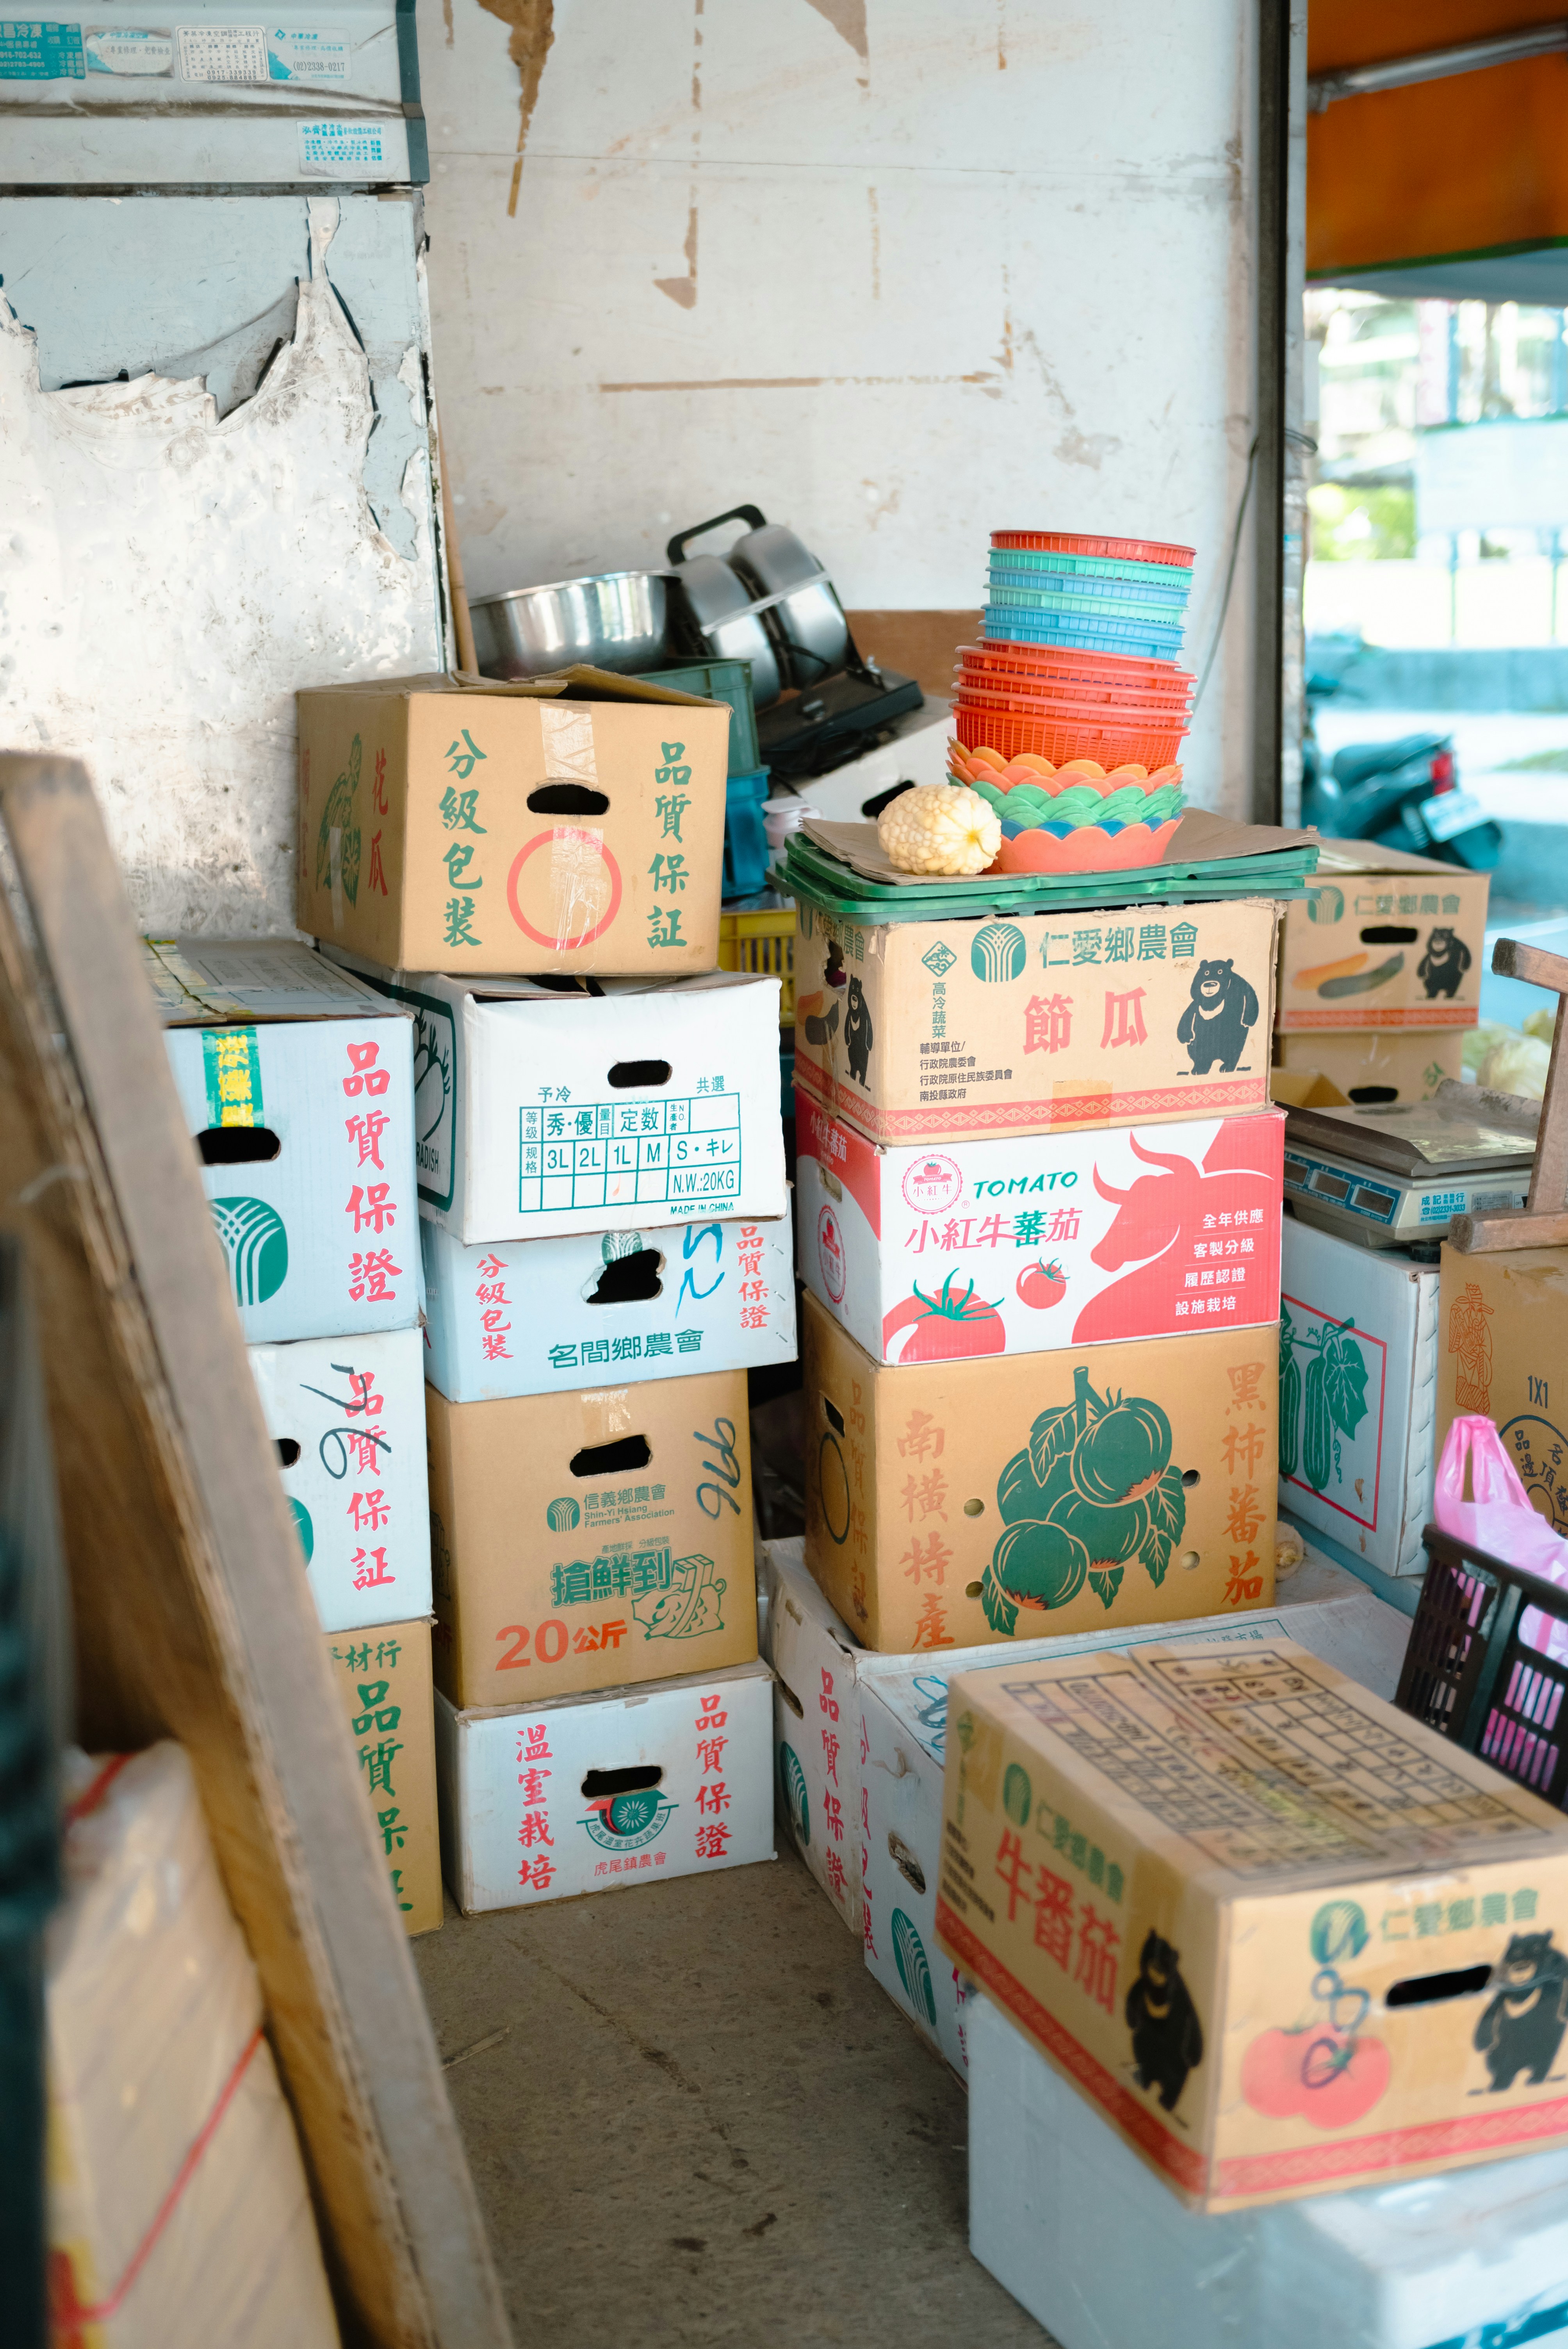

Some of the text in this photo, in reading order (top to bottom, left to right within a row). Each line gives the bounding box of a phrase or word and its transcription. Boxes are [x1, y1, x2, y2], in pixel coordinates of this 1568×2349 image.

[0, 23, 43, 38] 昌冷凍
[294, 61, 345, 71] (02)2338-0217
[438, 729, 488, 948] 分級包裝
[647, 741, 692, 949] 品質保証
[1039, 921, 1199, 969] 仁愛鄉農會
[932, 982, 947, 1039] 高冷蔬菜
[1022, 986, 1149, 1055] 節瓜
[919, 1056, 976, 1071] 行政院農委會
[696, 1075, 725, 1094] 共選
[919, 1069, 1013, 1087] 行政院原住民族委員會
[538, 1085, 572, 1103] 予冷
[919, 1088, 967, 1102] 南投縣政府
[599, 1108, 611, 1135] 量目
[416, 1142, 439, 1174] RADISH
[547, 1142, 661, 1169] 3L 2L 1L M
[342, 1041, 403, 1302] 品質保證
[973, 1171, 1078, 1199] TOMATO
[913, 1183, 952, 1197] 小紅牛
[670, 1205, 695, 1215] MADE
[709, 1202, 734, 1212] CHINA
[1202, 1208, 1264, 1229] 全年供應
[904, 1207, 1083, 1254] 小紅牛蕃茄
[1193, 1238, 1254, 1258] 客製分級
[735, 1225, 771, 1330] 品質保證
[475, 1253, 514, 1361] 分級包裝
[1175, 1296, 1237, 1316] 設施栽培
[547, 1328, 705, 1369] 名間鄉農會
[345, 1371, 396, 1592] 品質保証
[1221, 1362, 1267, 1607] 黑柿蕃茄
[584, 1484, 666, 1511] 信義鄉農會
[584, 1505, 648, 1520] Shin-Yi Hsiang
[585, 1510, 675, 1528] Farmers' Association
[897, 1408, 955, 1649] 南橫特產
[639, 1536, 670, 1549] 分級包裝
[551, 1547, 673, 1608] 搶鮮到
[694, 1693, 733, 1860] 品質保證
[594, 1851, 667, 1877] 虎尾鎮農會
